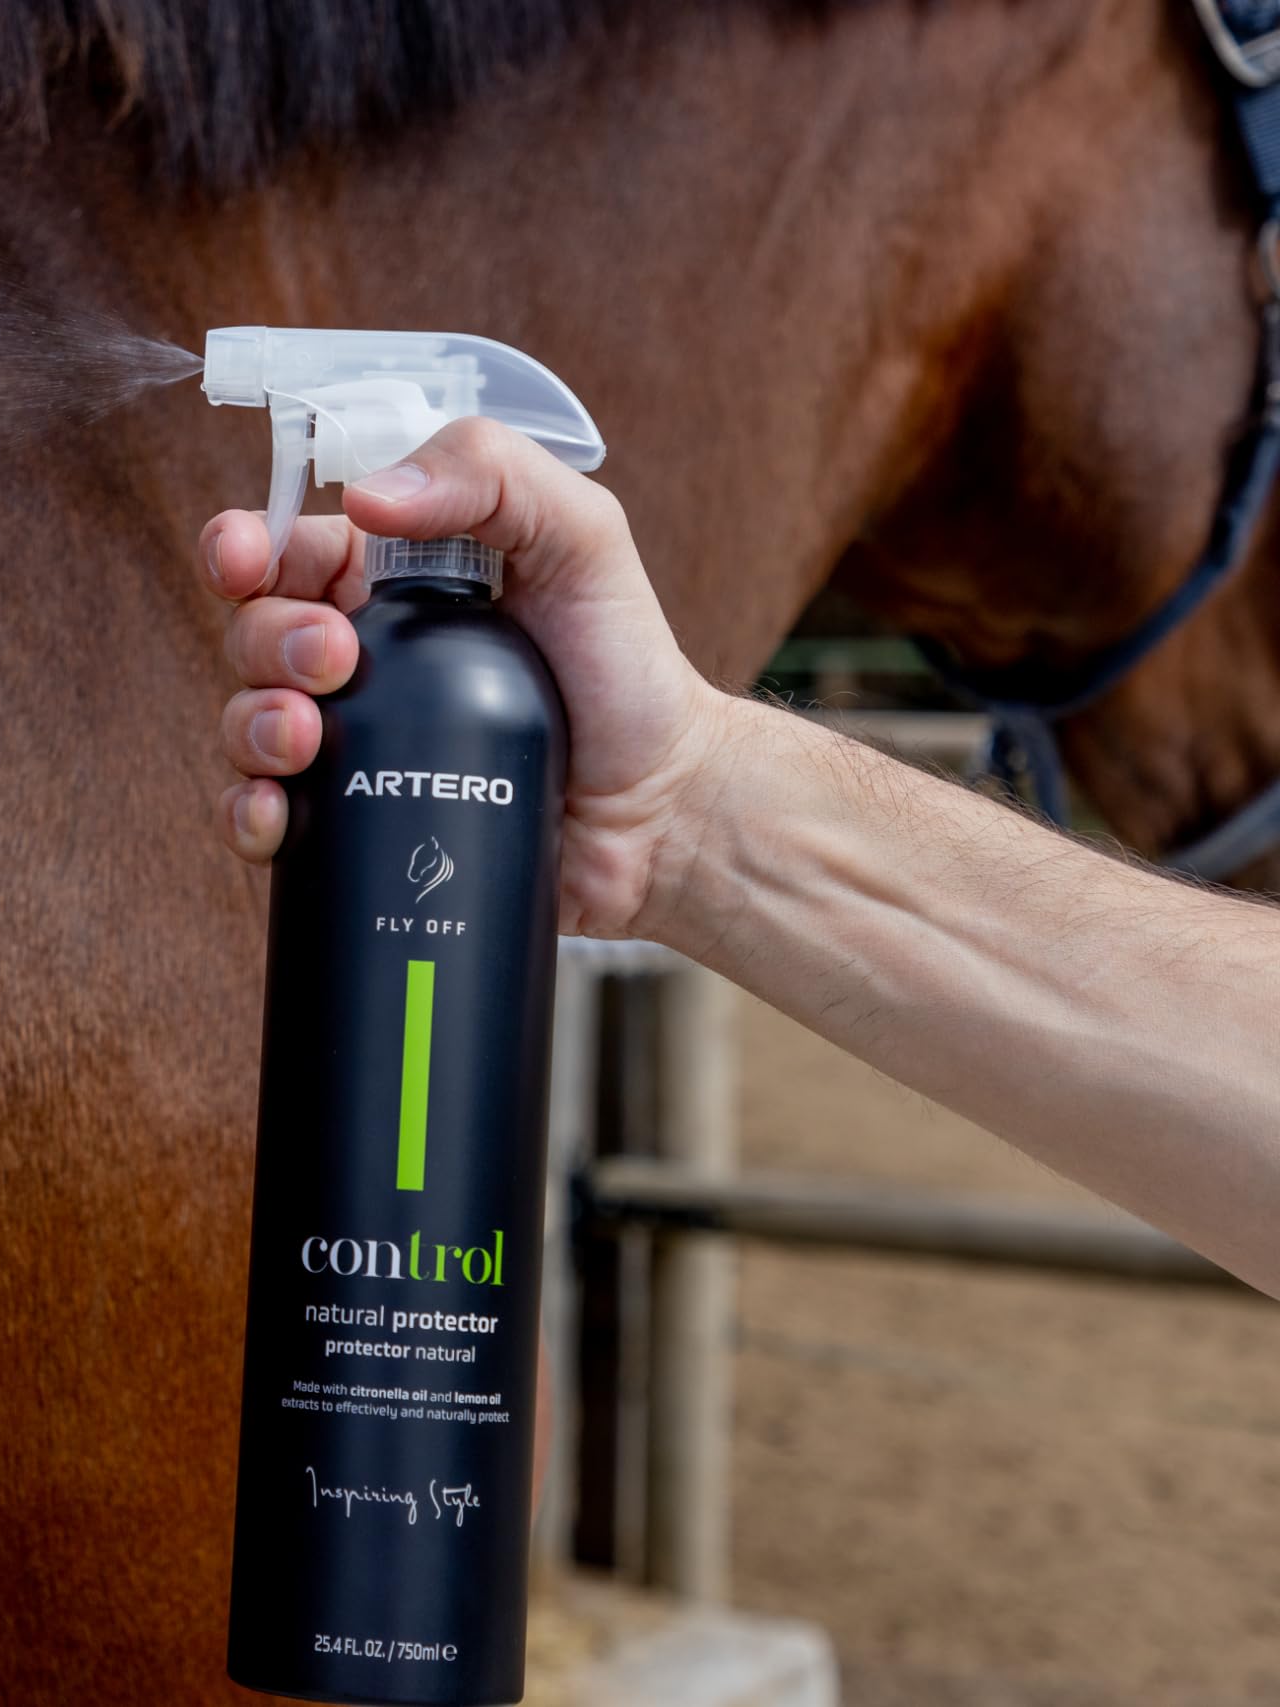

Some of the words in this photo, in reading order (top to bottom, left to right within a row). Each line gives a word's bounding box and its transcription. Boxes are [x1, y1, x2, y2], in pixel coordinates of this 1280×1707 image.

[343, 770, 513, 805] ARTERO
[376, 917, 415, 932] FLY
[425, 919, 467, 936] OFF
[301, 1229, 505, 1286] control
[305, 1303, 385, 1327] natural
[392, 1310, 499, 1334] protector
[325, 1338, 411, 1359] protector
[415, 1346, 476, 1364] natural
[293, 1380, 320, 1393] Made
[322, 1383, 348, 1396] with
[350, 1387, 409, 1401] citronella
[411, 1390, 428, 1401] oil
[430, 1391, 452, 1403] and
[454, 1392, 489, 1405] lemon
[489, 1393, 501, 1405] oil
[281, 1397, 320, 1411] extracts
[321, 1399, 333, 1412] to
[335, 1401, 398, 1420] effectively
[400, 1407, 424, 1419] and
[426, 1408, 477, 1424] naturally
[478, 1411, 510, 1424] protect
[305, 1465, 418, 1526] Inspiring
[428, 1479, 481, 1528] Style
[314, 1634, 342, 1654] 25.4
[344, 1638, 363, 1656] FL.
[365, 1640, 386, 1658] OZ.
